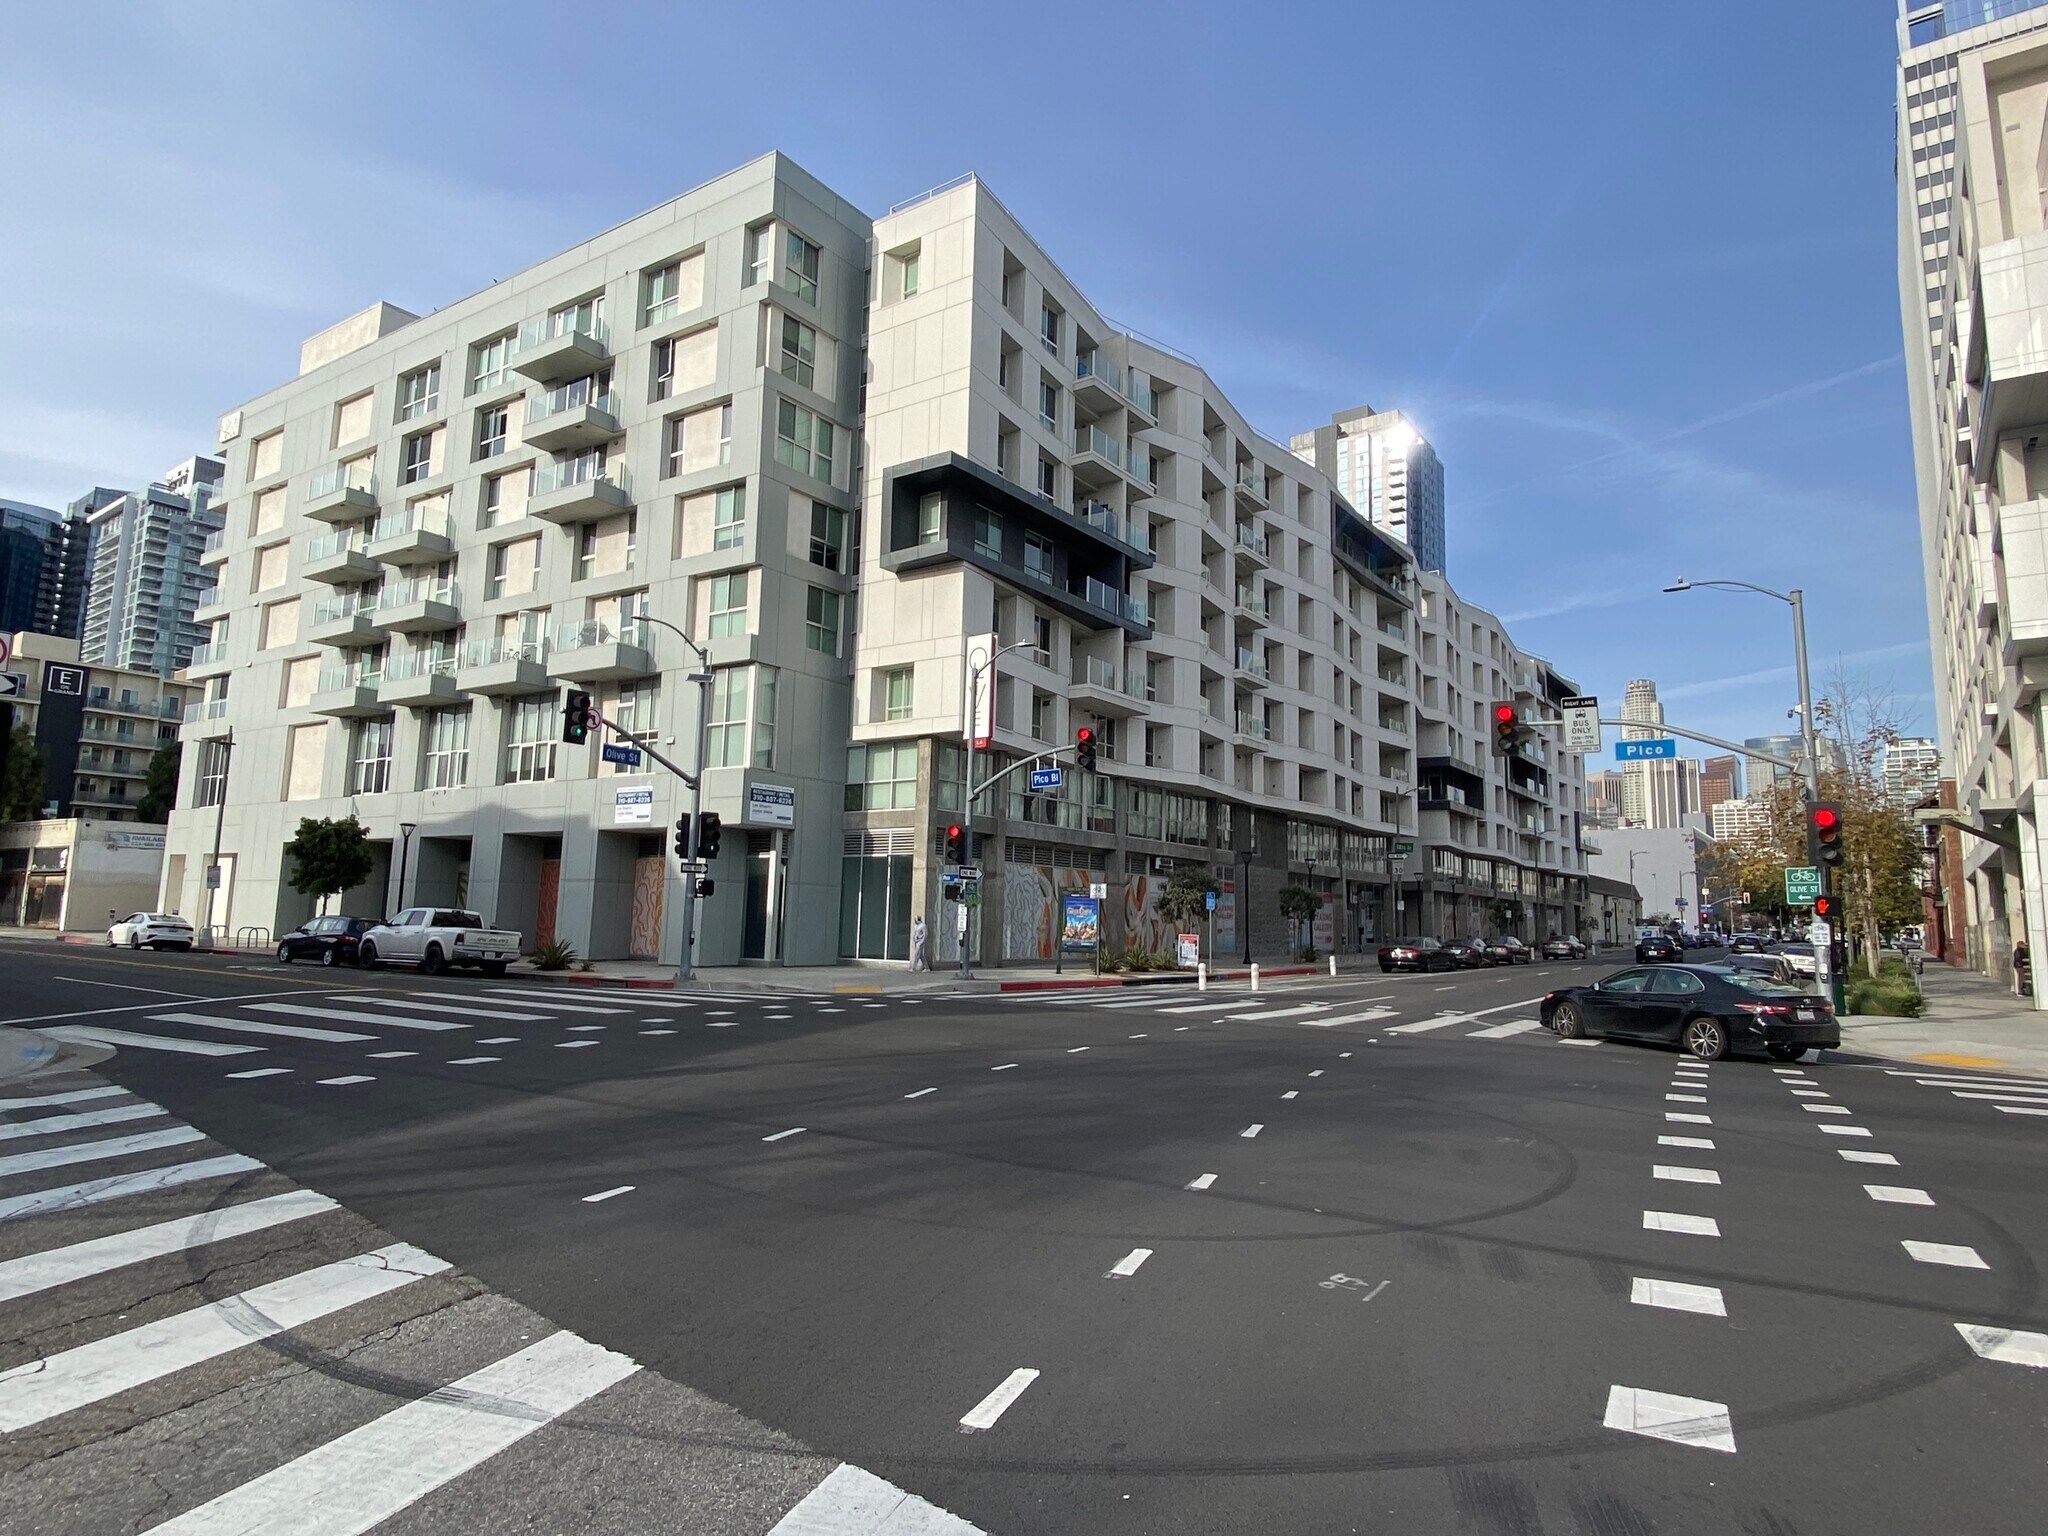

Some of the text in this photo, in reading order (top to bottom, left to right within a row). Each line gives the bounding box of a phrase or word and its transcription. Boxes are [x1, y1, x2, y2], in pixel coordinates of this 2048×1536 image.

[60, 671, 73, 685] E
[606, 748, 638, 762] Olive St
[1626, 745, 1664, 756] Pico
[1033, 773, 1059, 784] Pico Bl
[1789, 885, 1818, 893] OLIVE ST
